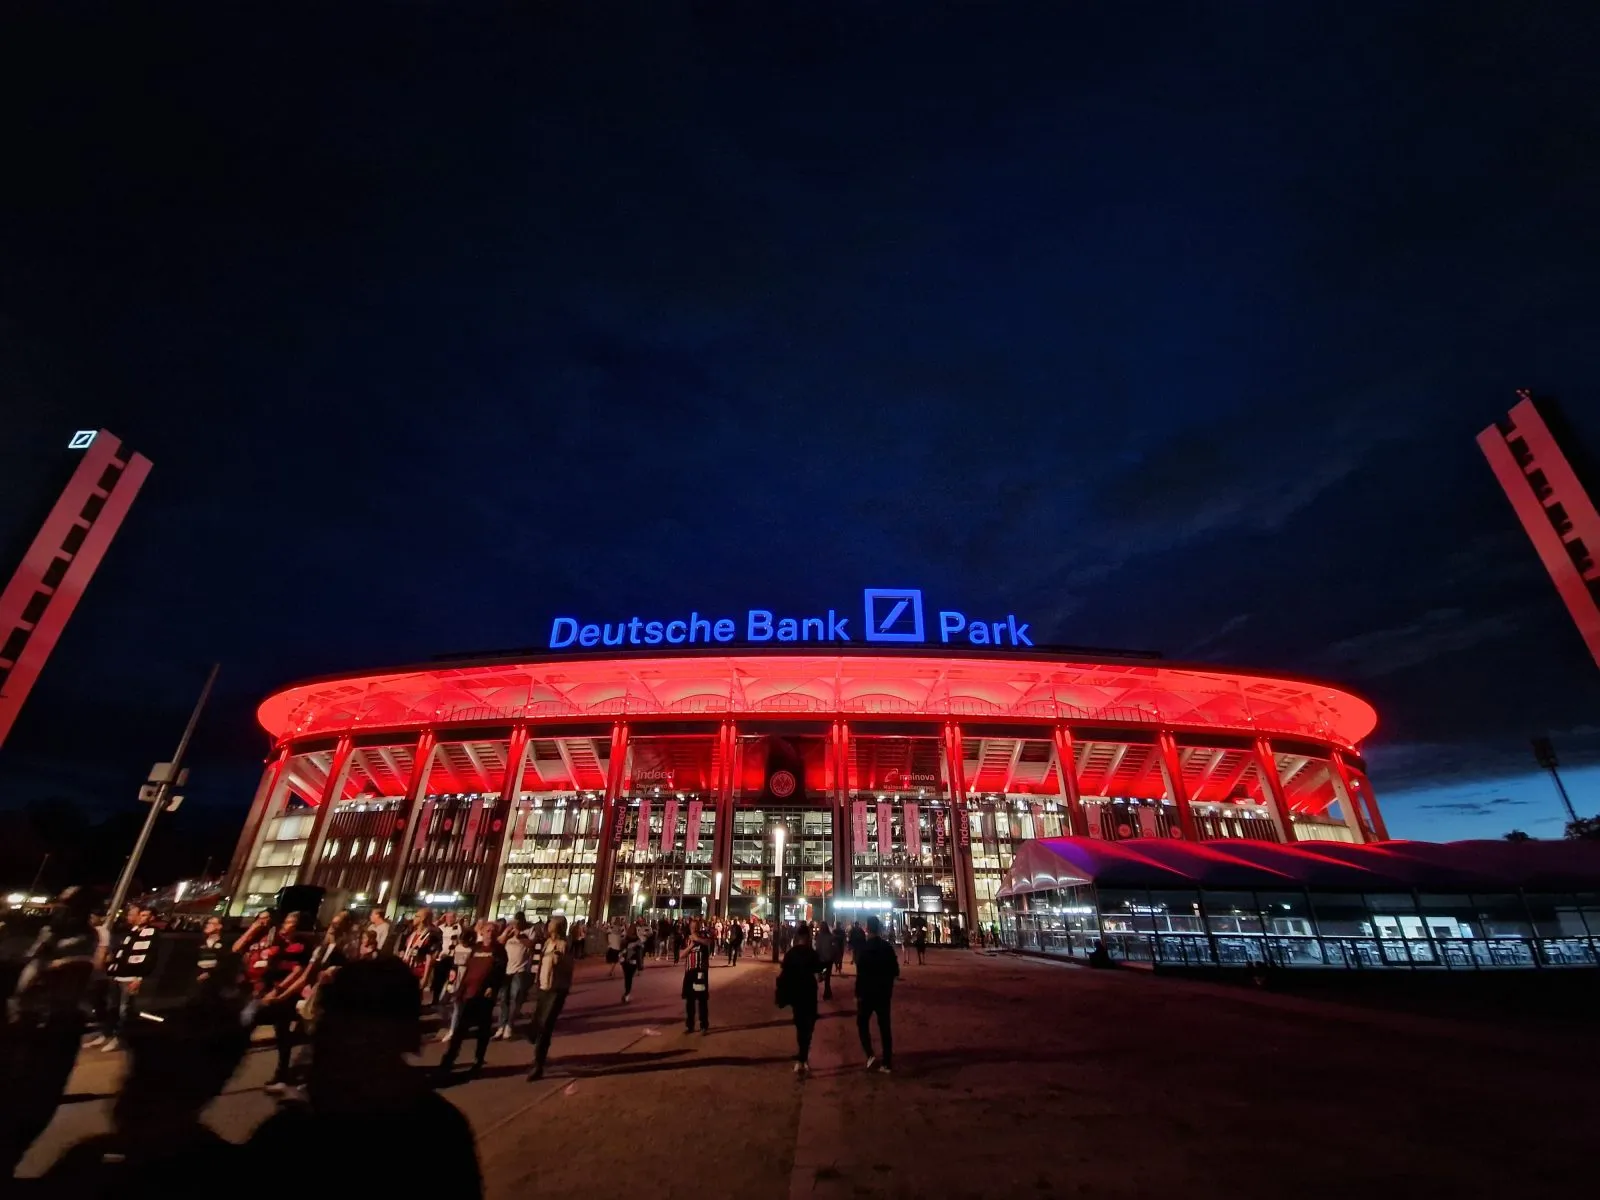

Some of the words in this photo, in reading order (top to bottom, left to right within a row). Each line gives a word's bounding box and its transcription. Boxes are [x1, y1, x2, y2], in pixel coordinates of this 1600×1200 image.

[549, 611, 735, 648] Deutsche
[747, 609, 851, 642] Bank
[939, 610, 1035, 647] Park
[636, 769, 675, 780] indeed
[613, 805, 627, 843] indeed
[935, 809, 945, 847] indeed
[959, 808, 969, 846] indeed
